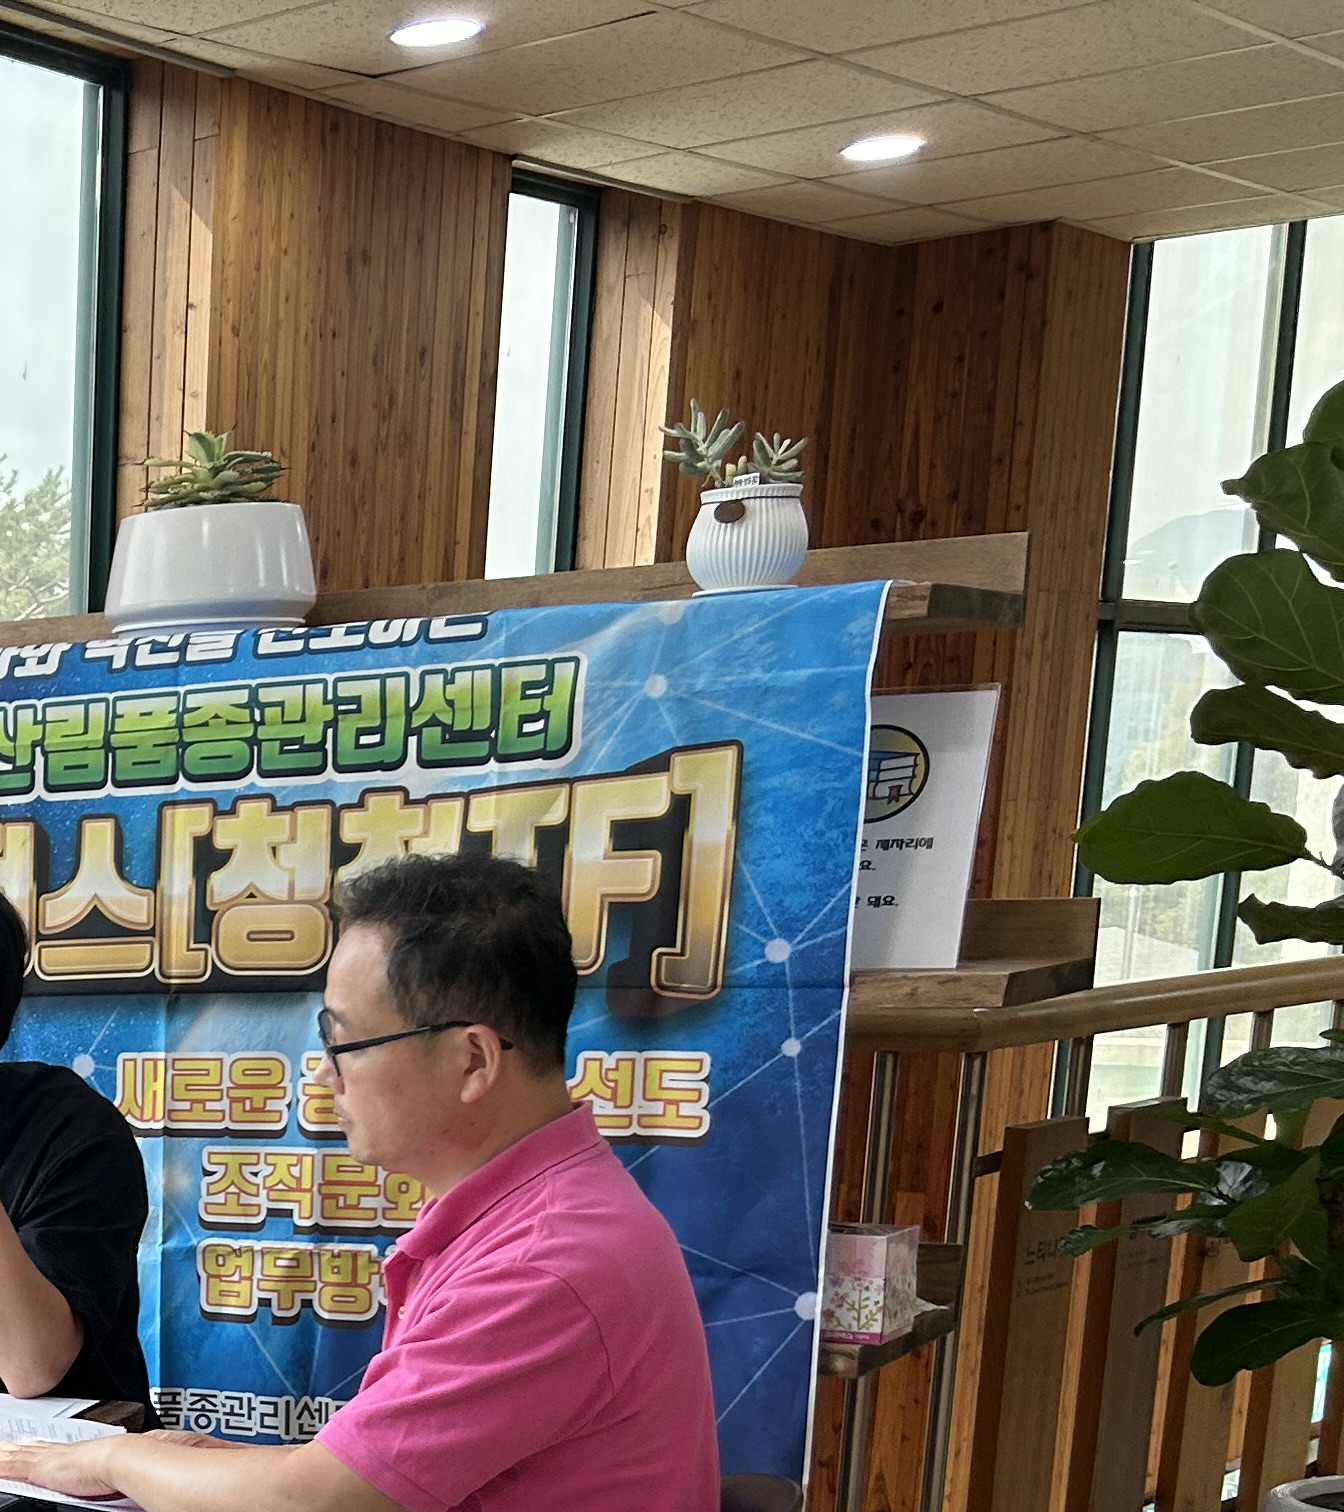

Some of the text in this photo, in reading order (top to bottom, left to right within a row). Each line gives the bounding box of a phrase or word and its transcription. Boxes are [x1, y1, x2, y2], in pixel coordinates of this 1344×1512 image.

[874, 836, 935, 851] 제자리에
[114, 1055, 289, 1126] 새로운
[202, 1242, 385, 1315] 업무방
[154, 1391, 346, 1436] 품종관리센
